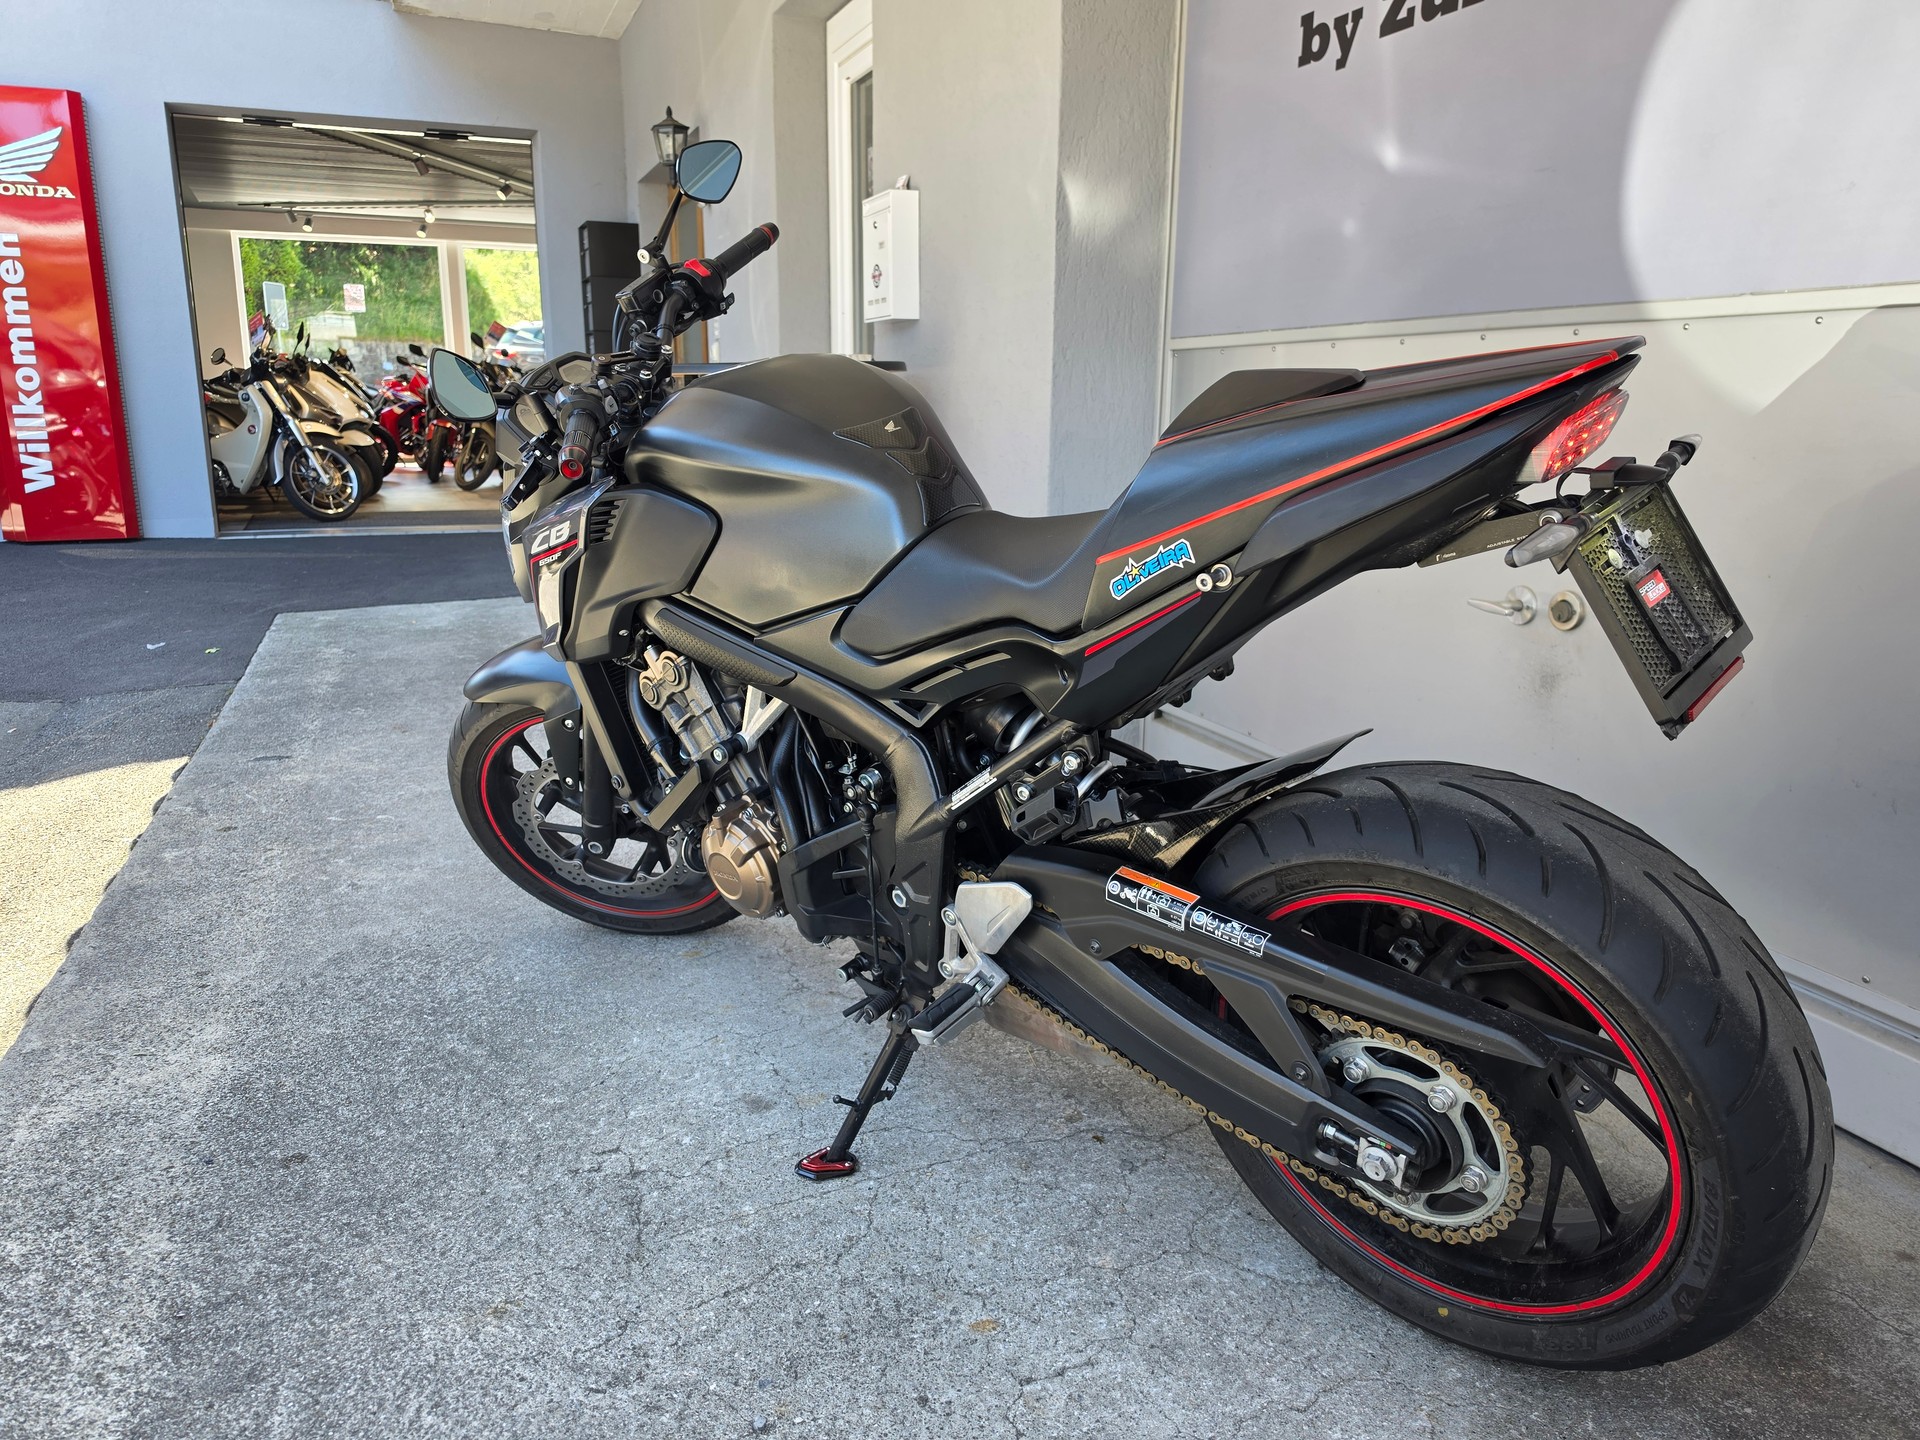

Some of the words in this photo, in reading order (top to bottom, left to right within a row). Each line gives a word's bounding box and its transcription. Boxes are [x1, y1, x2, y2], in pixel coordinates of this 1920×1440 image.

[1298, 6, 1363, 71] by
[1379, 0, 1485, 39] Zu
[0, 183, 76, 199] ONDA
[0, 232, 55, 494] Willkommen
[531, 520, 571, 555] CB
[1112, 541, 1192, 598] OLIVEIRA
[1643, 1307, 1669, 1331] SPORT
